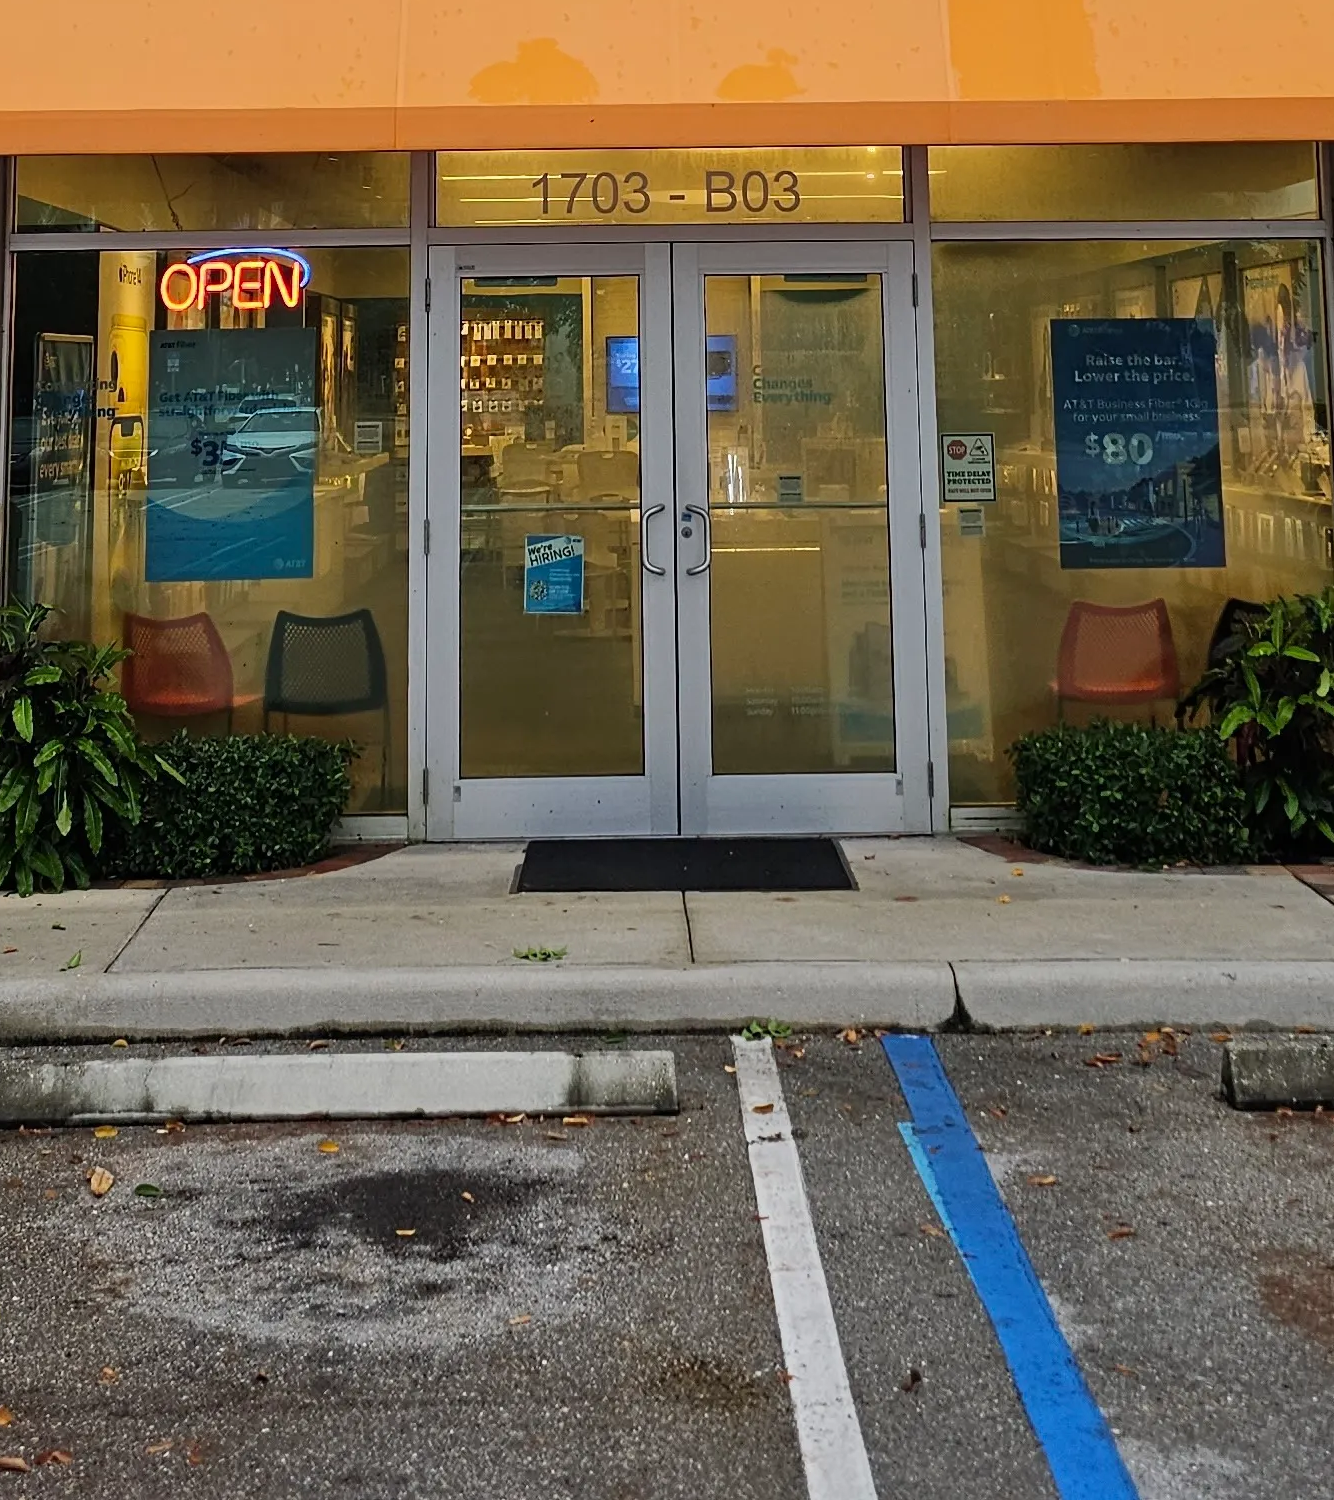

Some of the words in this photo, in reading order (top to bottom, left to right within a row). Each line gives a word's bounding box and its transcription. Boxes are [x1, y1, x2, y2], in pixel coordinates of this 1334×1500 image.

[532, 171, 652, 216] 1703
[704, 169, 803, 214] B03
[160, 261, 301, 312] OPEN
[1085, 354, 1124, 367] Raise
[1074, 369, 1121, 383] Lower
[1123, 369, 1150, 382] the
[1152, 369, 1196, 385] price.
[1091, 412, 1117, 426] your
[948, 445, 967, 455] STOP
[1084, 431, 1155, 466] $80
[947, 470, 966, 478] TIME
[967, 470, 991, 478] DELAY
[947, 478, 992, 486] PROTECTED
[527, 543, 553, 557] We're
[528, 545, 576, 567] HIRING!
